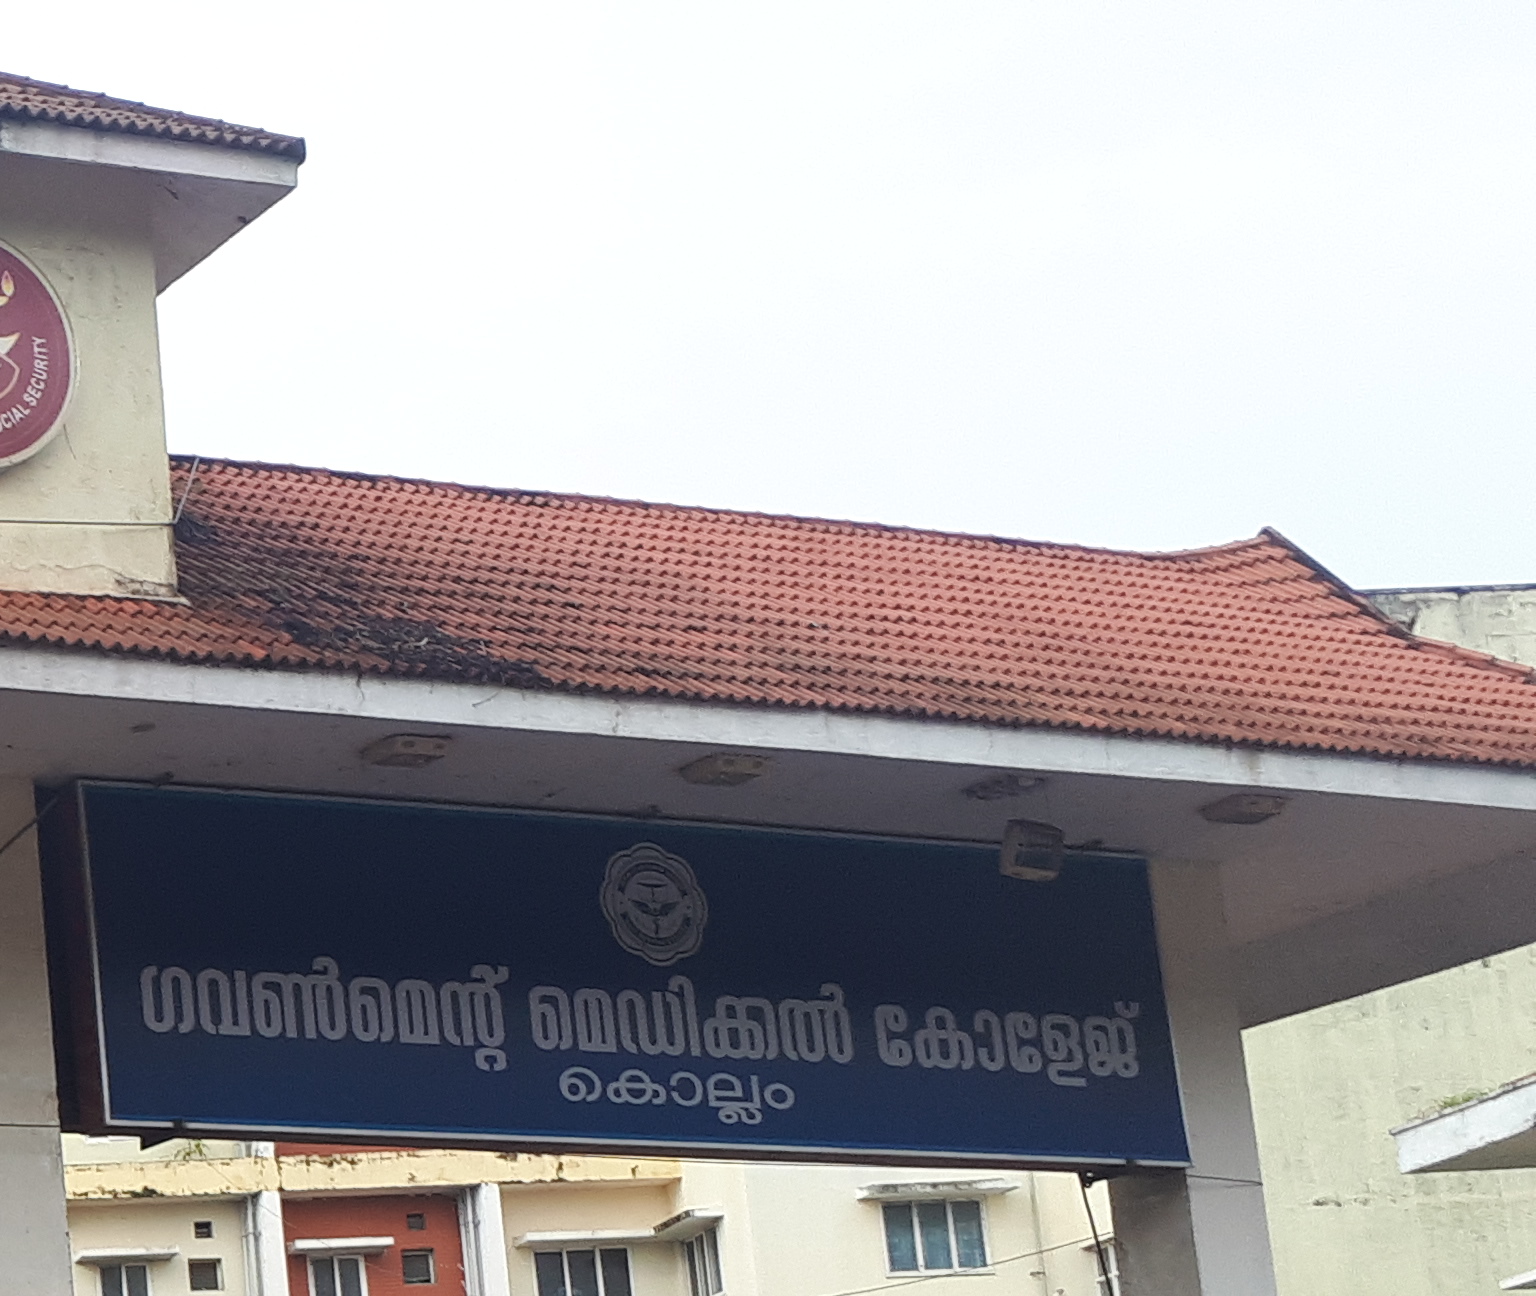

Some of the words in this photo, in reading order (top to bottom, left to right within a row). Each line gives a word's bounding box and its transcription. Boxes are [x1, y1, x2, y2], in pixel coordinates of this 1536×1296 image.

[23, 336, 49, 407] SECURITY
[527, 975, 857, 1066] മെഡിക്കൽ
[874, 1000, 1142, 1087] കോളേജ്
[559, 1064, 797, 1125] കൊല്ലം
